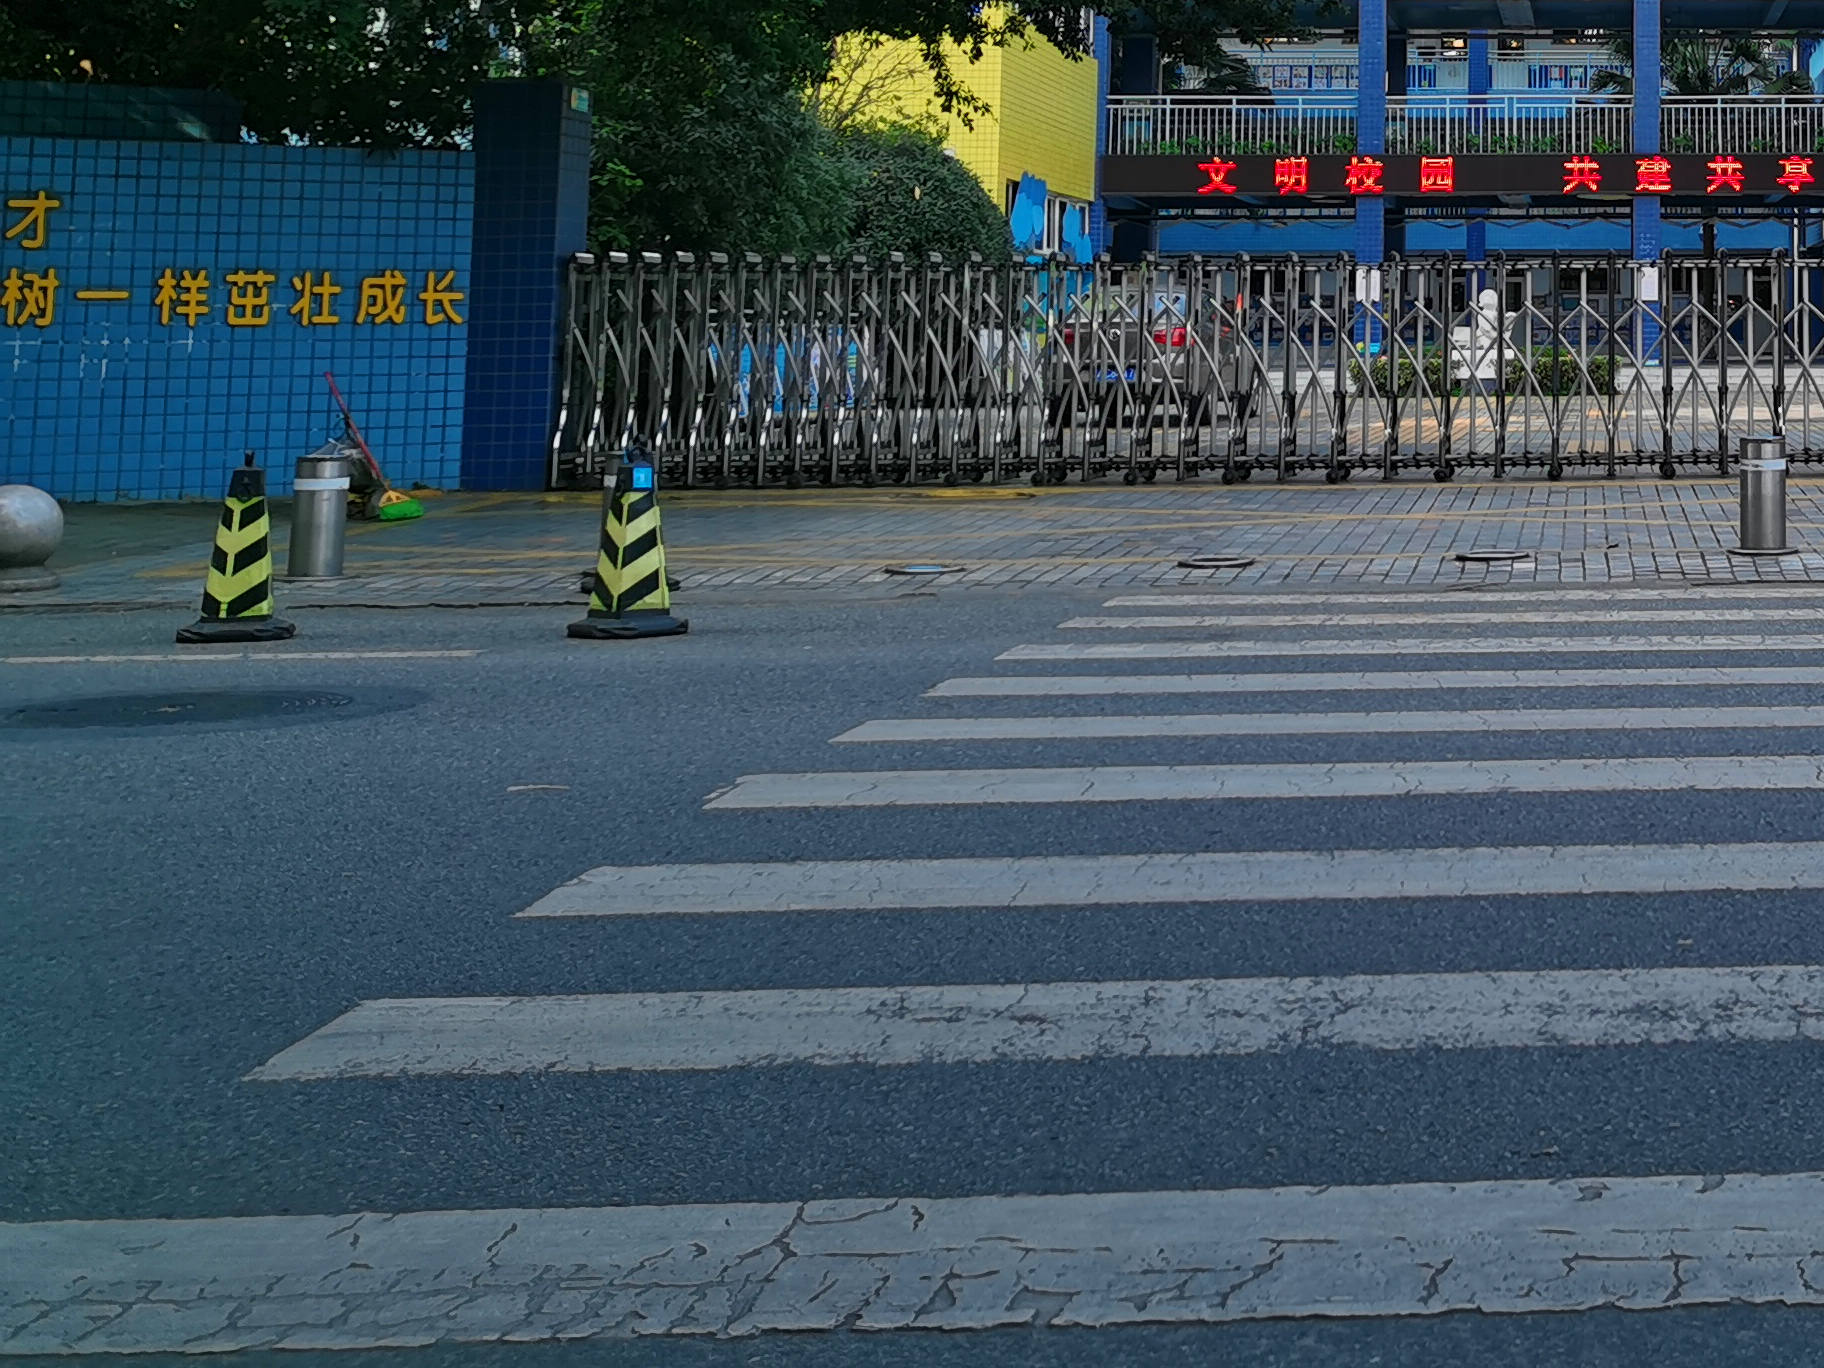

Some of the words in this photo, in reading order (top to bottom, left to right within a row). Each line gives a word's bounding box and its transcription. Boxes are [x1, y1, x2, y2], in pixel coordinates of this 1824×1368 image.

[1197, 156, 1455, 195] 文明校园
[3, 190, 61, 248] 才
[1, 268, 466, 328] 树一样茁壮成长
